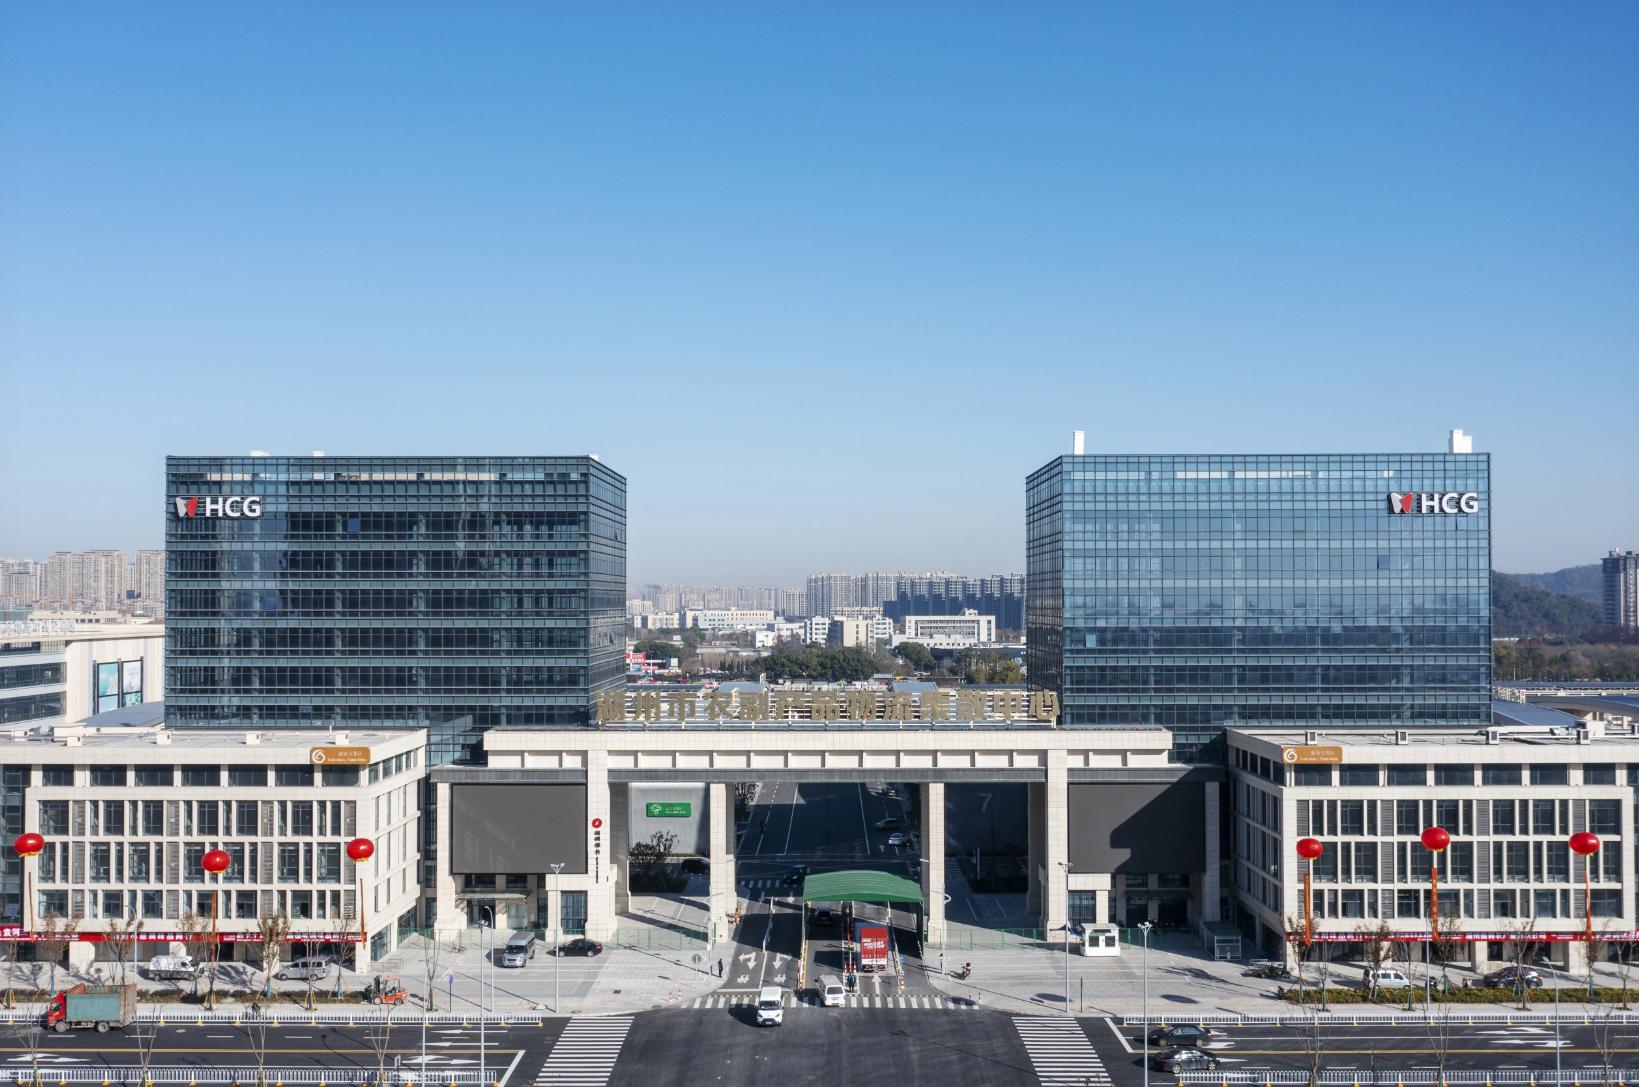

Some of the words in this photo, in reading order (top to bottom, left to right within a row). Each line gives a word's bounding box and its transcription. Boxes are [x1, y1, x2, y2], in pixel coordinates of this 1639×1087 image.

[205, 496, 261, 517] HCG
[1421, 492, 1479, 514] HCG
[596, 690, 1060, 721] 湖州市农副产品物流集散中心
[978, 792, 993, 813] 7
